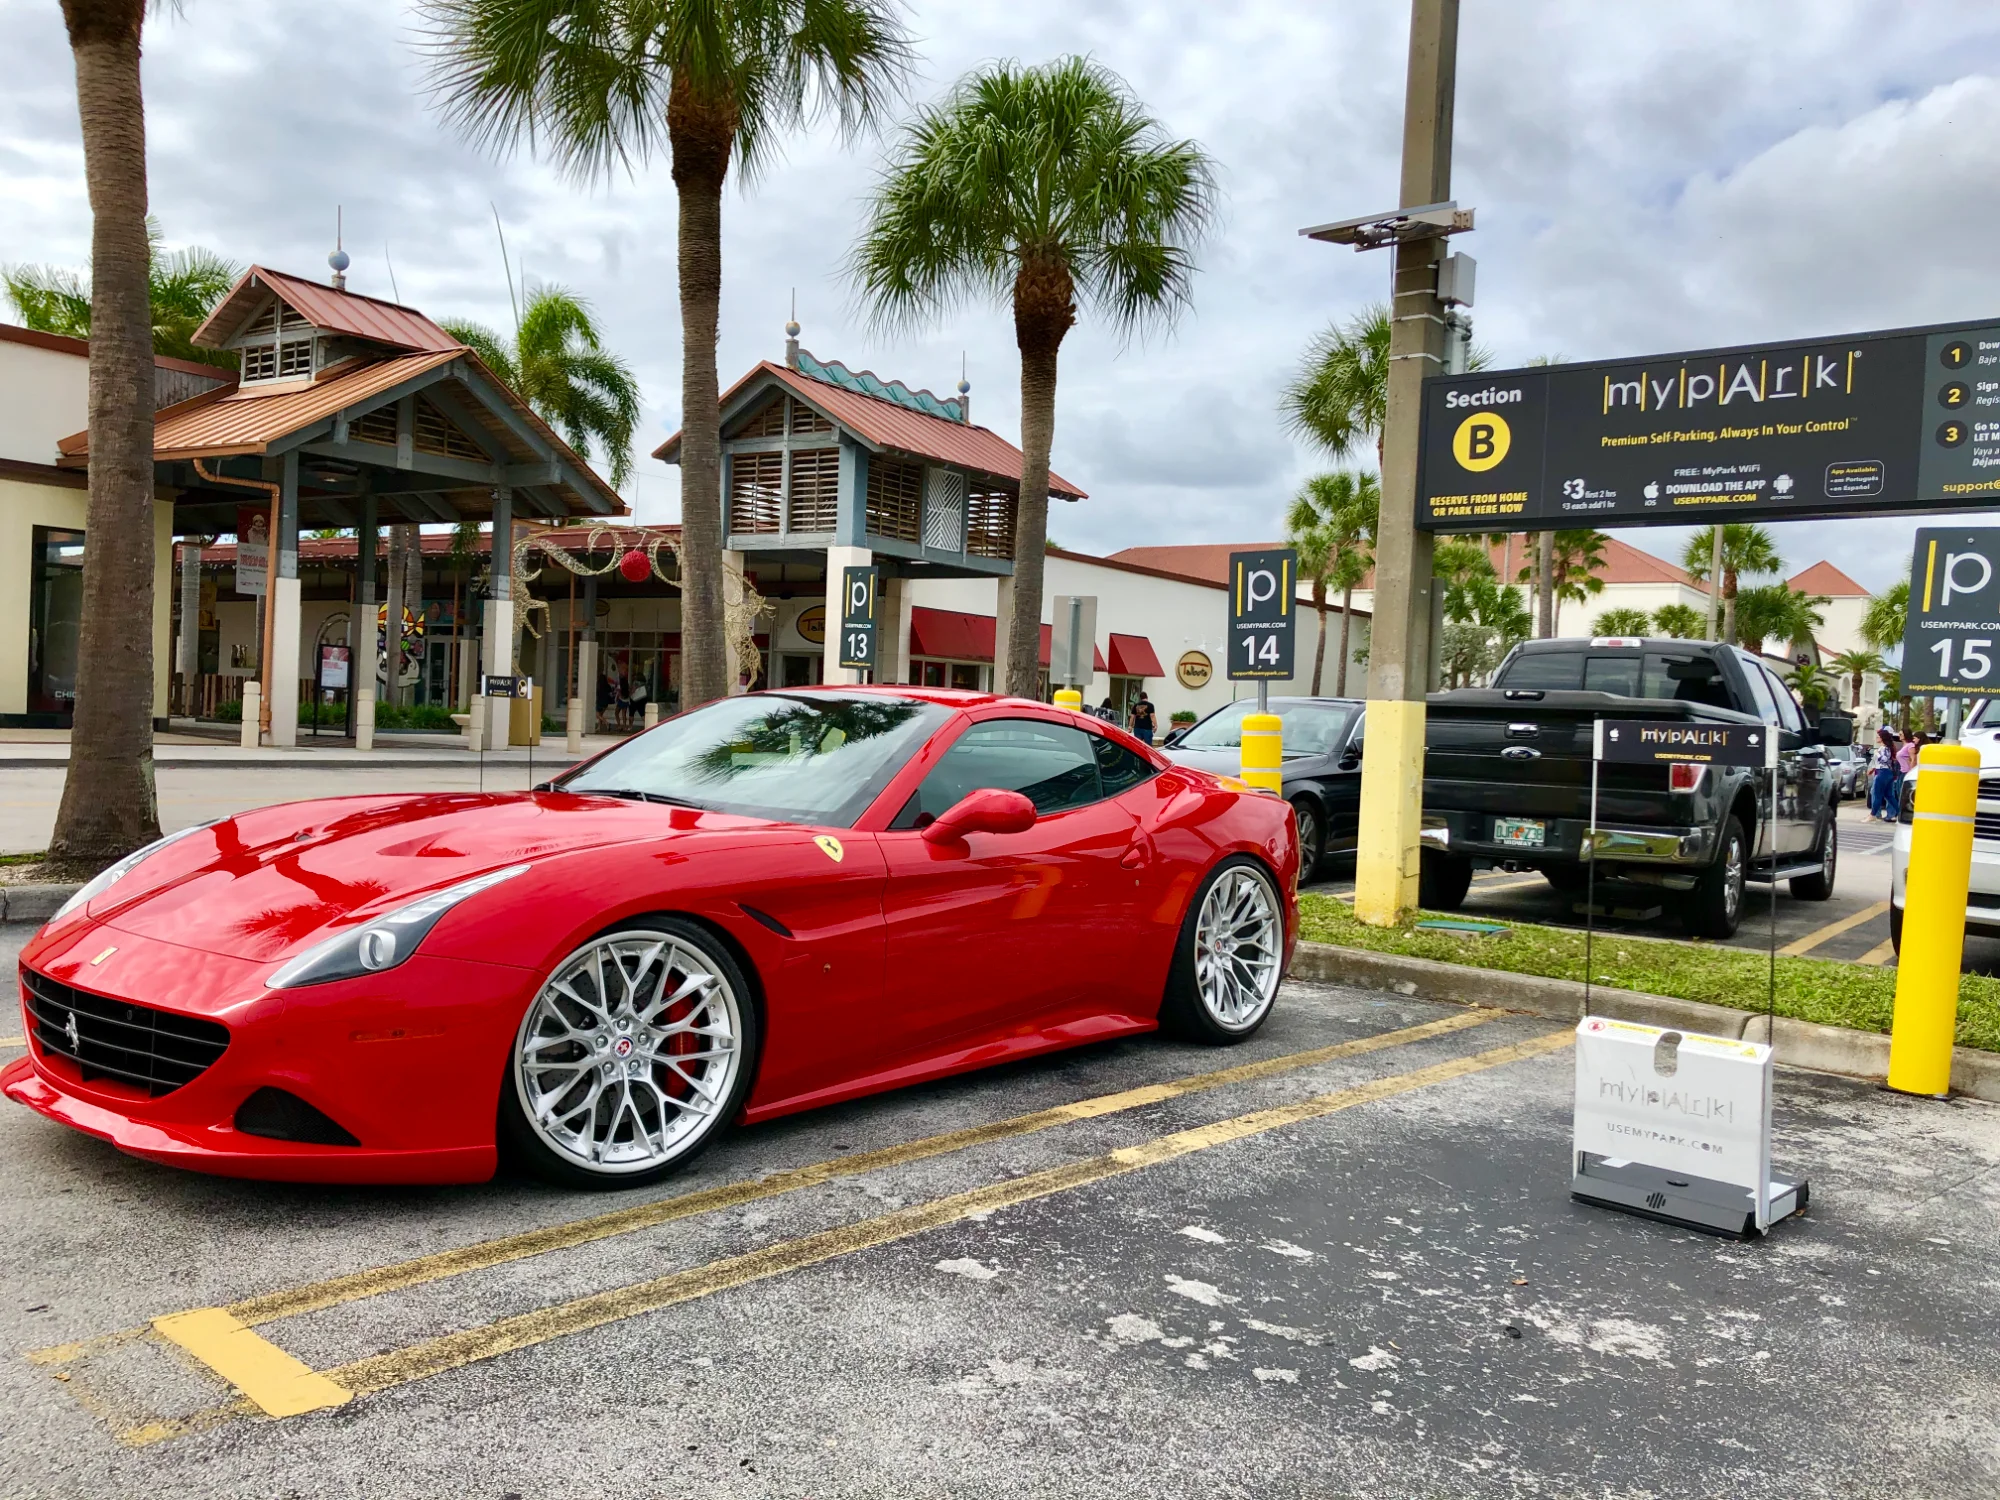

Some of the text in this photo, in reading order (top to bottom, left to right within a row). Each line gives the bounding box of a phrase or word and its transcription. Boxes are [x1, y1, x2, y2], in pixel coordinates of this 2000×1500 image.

[1951, 347, 1960, 362] 1
[1978, 355, 1998, 366] Baje
[1445, 387, 1522, 408] Section
[1948, 381, 1999, 403] 2 Sign
[1468, 423, 1495, 460] B
[1601, 418, 1850, 447] Premium Self-Parking, Always In Your Control
[1945, 422, 2000, 442] 3 Go to
[1973, 432, 1989, 442] LET
[1973, 447, 1993, 457] Vaya
[1673, 463, 1761, 477] FREE: MyPark WiFi
[1562, 478, 1585, 499] $3
[1599, 490, 1605, 498] 2
[1665, 480, 1767, 494] DOWNLOAD THE APP
[1430, 491, 1528, 506] RESERVE FROM HOME
[1673, 493, 1757, 505] USEMYPARK.COM
[1432, 503, 1524, 516] OR PARK HERE NOW
[847, 633, 868, 658] 13
[1242, 635, 1280, 665] 14
[1930, 638, 1992, 680] 15
[1607, 1122, 1723, 1155] USEMYPARK.COM
